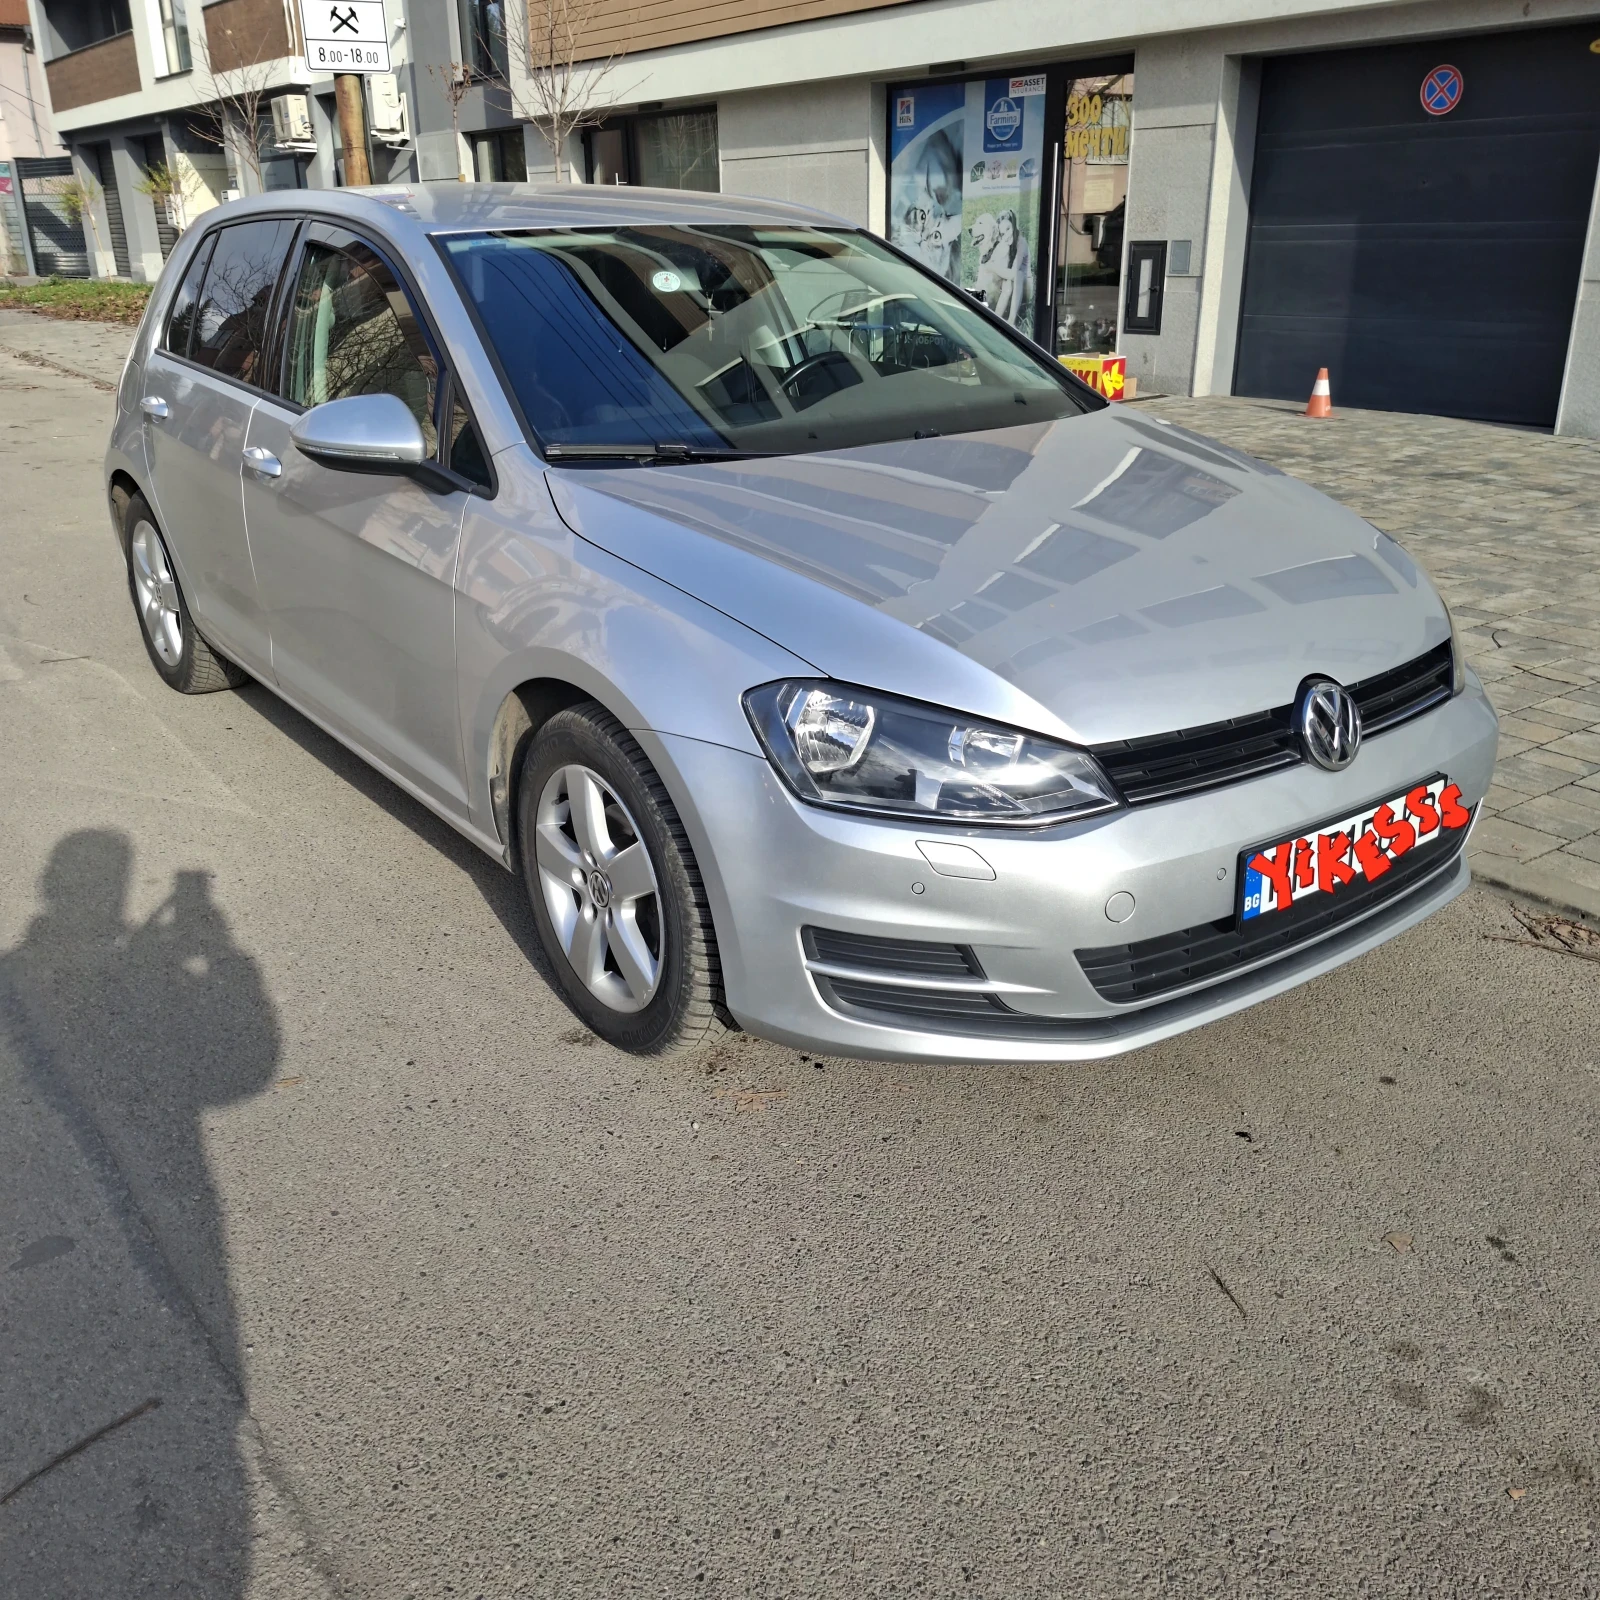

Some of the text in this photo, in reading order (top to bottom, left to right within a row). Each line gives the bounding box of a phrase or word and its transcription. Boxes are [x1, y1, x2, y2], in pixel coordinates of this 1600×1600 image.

[318, 46, 379, 64] 8.00-18.00
[1010, 85, 1045, 94] INSURANCE
[1023, 77, 1046, 87] ASSET
[990, 113, 1018, 125] Farmina
[525, 736, 559, 781] KUMHO
[1244, 893, 1260, 912] BG
